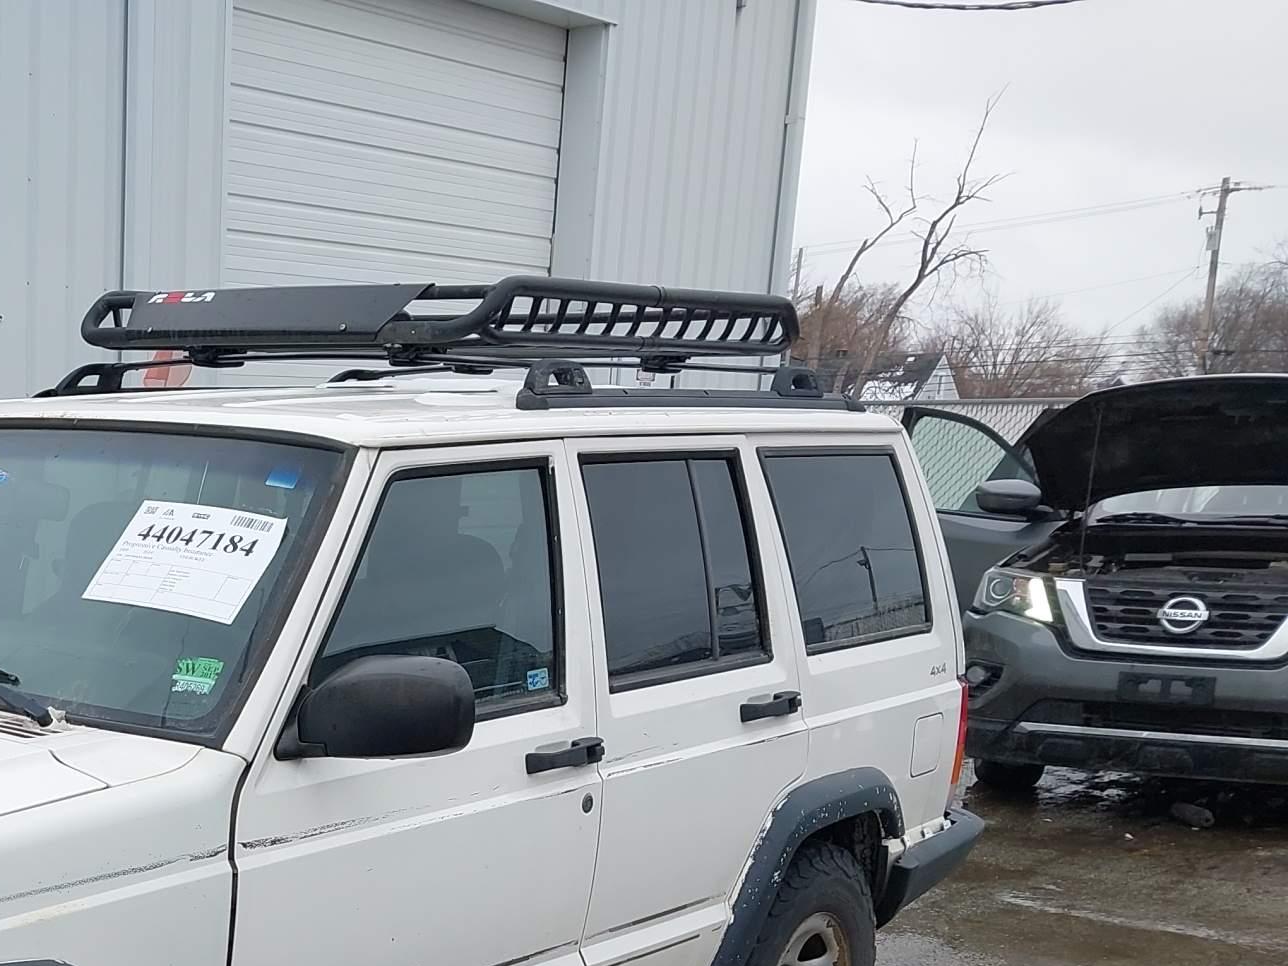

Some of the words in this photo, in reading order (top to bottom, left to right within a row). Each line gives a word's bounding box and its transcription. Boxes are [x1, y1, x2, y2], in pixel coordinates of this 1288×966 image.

[147, 291, 216, 304] ROLA
[137, 522, 261, 557] 44047184
[1162, 610, 1203, 619] NISSAN
